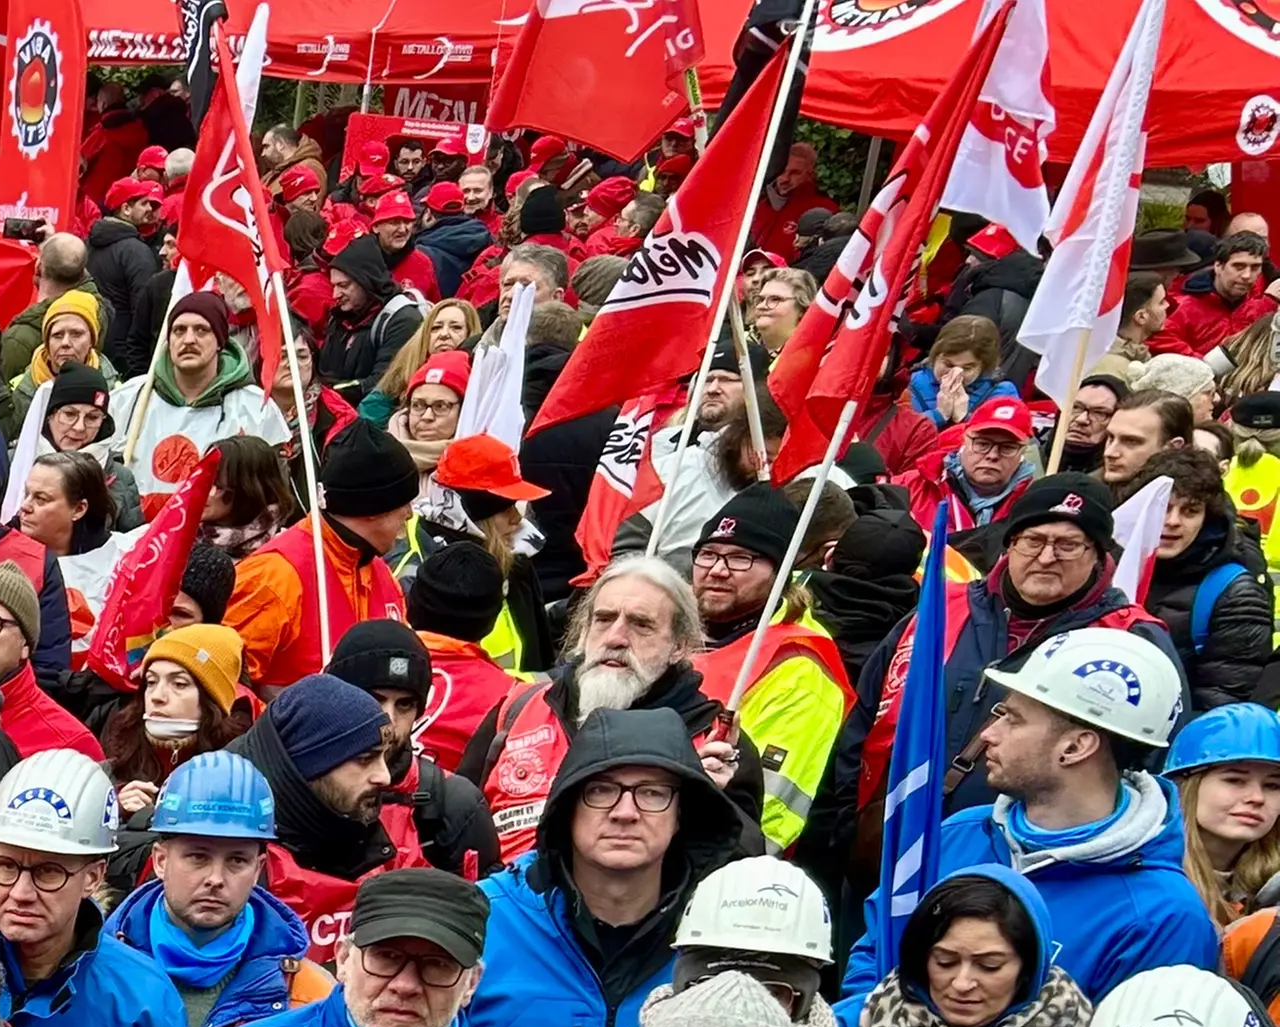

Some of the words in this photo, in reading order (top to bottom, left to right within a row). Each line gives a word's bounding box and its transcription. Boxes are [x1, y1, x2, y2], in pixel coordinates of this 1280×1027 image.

[1084, 661, 1139, 697] ACLVB
[8, 788, 72, 821] ACLVB
[721, 897, 789, 912] ArcelorMittal
